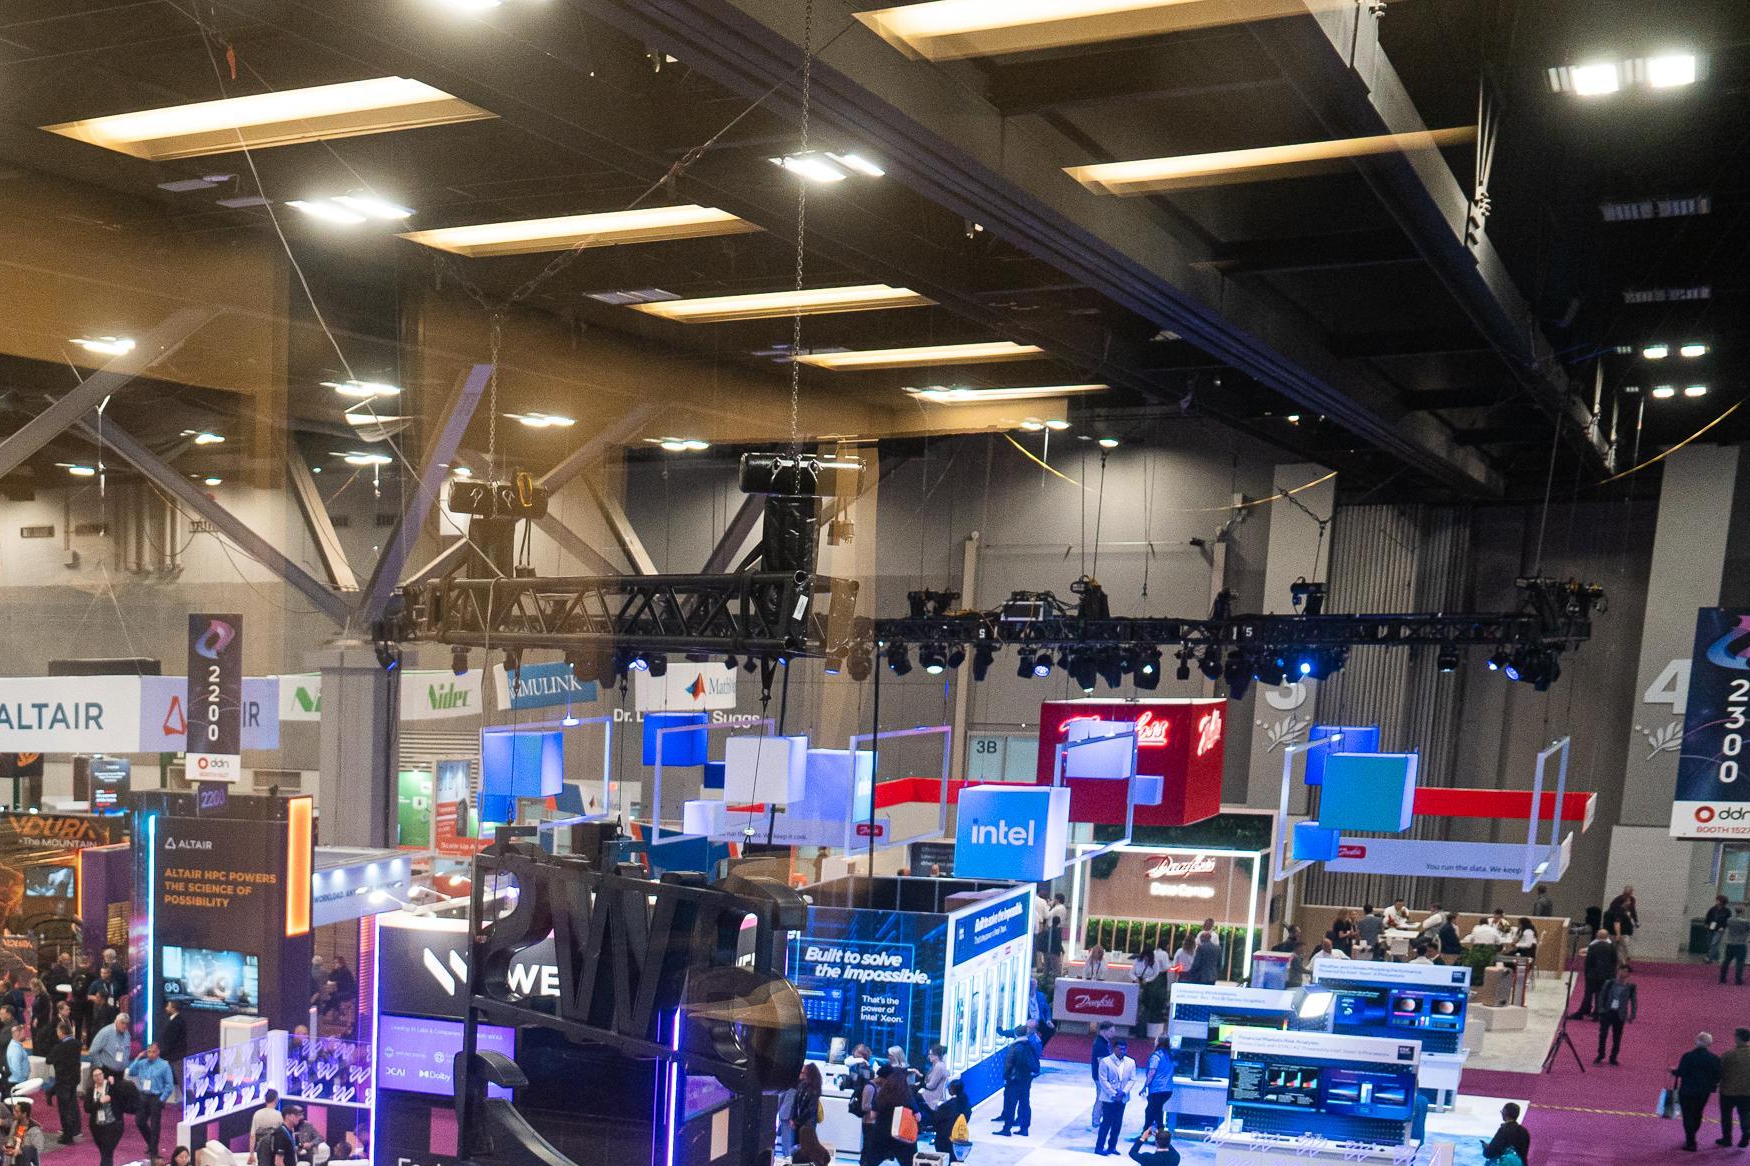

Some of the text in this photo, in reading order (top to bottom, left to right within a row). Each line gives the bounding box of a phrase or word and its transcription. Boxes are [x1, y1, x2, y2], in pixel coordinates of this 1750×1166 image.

[207, 665, 221, 742] 2200
[614, 709, 632, 722] Dr.
[1719, 679, 1750, 784] 2300
[976, 740, 998, 754] 3B
[971, 818, 1035, 847] intel
[179, 838, 213, 850] ALTAIR
[165, 868, 277, 883] ALTAIR HPC POWERS
[165, 881, 251, 895] THE SCIENCE OF
[164, 894, 230, 907] POSSIBILITY
[805, 946, 903, 967] Built to solve
[815, 963, 932, 984] the impossible.
[862, 995, 900, 1005] That's the
[860, 1005, 895, 1015] power of
